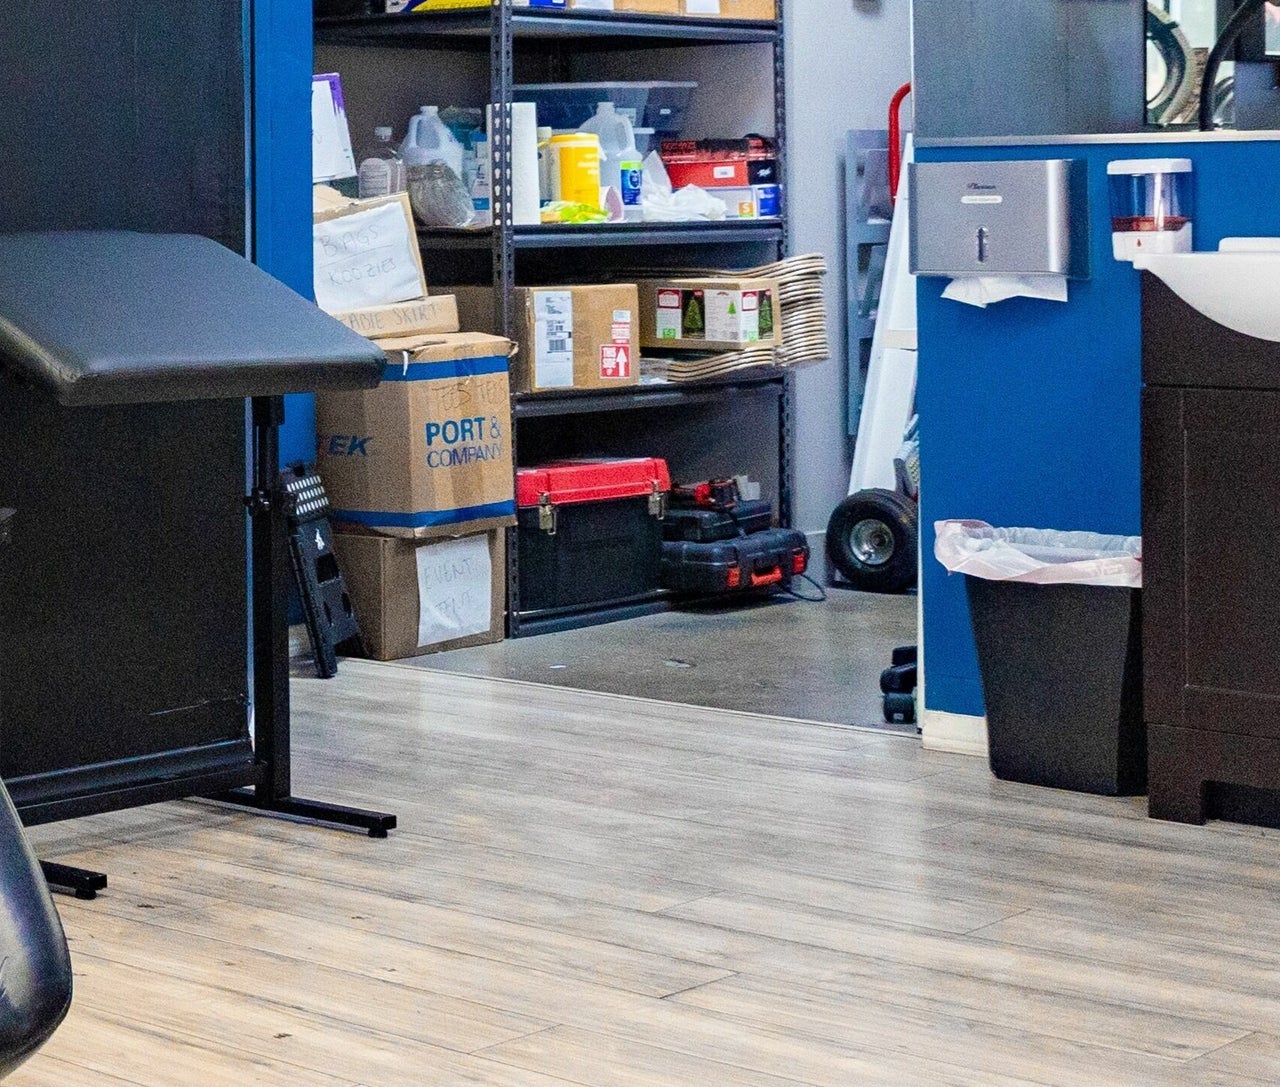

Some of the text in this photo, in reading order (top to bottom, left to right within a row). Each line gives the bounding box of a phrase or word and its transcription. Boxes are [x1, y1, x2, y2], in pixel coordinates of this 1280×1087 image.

[320, 223, 380, 258] BAGS
[328, 257, 397, 286] KOOZIES
[425, 415, 502, 446] PORT &
[426, 442, 502, 469] COMPANY
